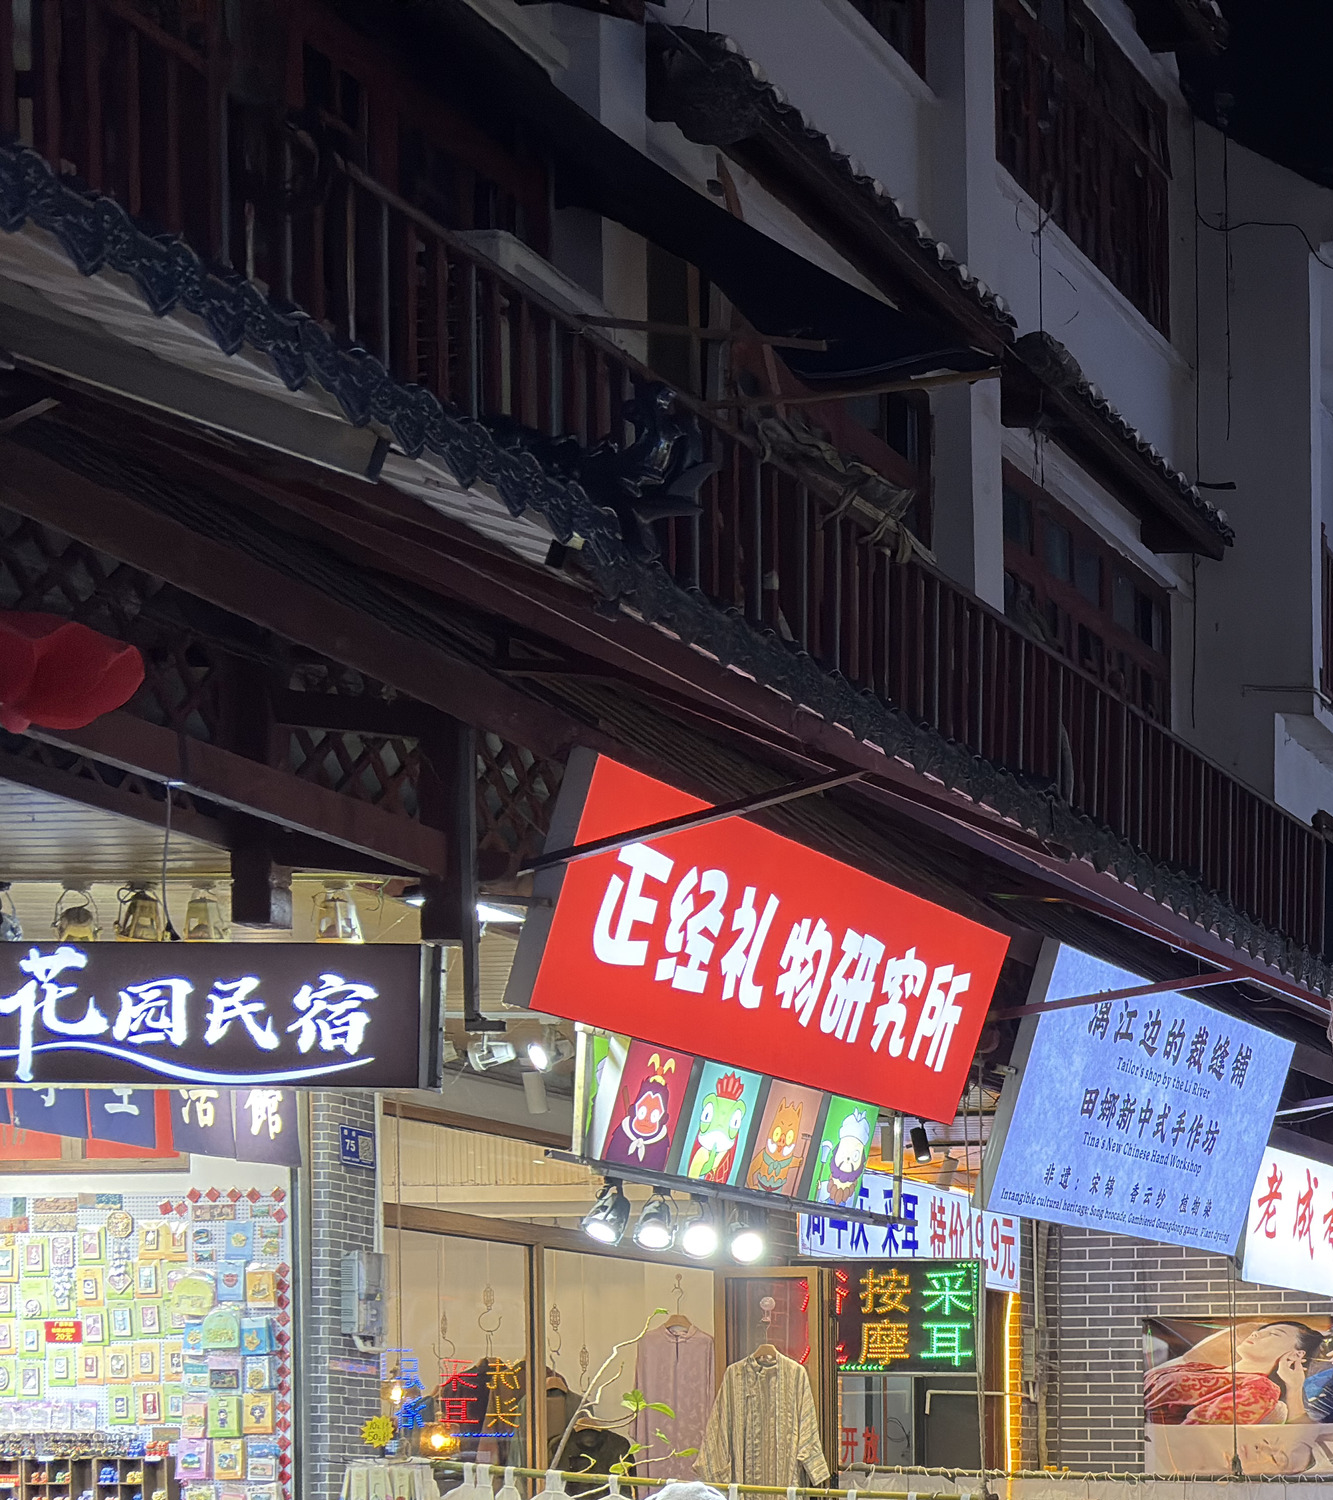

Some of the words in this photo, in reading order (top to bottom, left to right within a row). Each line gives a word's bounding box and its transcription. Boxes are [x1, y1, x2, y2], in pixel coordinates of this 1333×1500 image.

[593, 842, 971, 1072] 正经礼物研究所
[0, 945, 379, 1082] 花园民宿
[1087, 990, 1253, 1089] 漓江边的裁缝铺
[1116, 1056, 1145, 1078] Tailor's
[1145, 1066, 1162, 1087] shop
[1163, 1072, 1172, 1088] by
[1172, 1077, 1184, 1092] the
[1184, 1079, 1192, 1093] Li
[1192, 1082, 1211, 1100] River
[345, 1139, 356, 1151] 75
[1080, 1087, 1220, 1155] 田娜新中式手作坊
[1084, 1131, 1106, 1150] Tina's
[1107, 1136, 1122, 1154] New
[1123, 1142, 1150, 1162] Chinese
[1150, 1149, 1169, 1166] Hand
[1169, 1154, 1202, 1177] Workshop
[1001, 1186, 1036, 1206] Intangible
[1037, 1195, 1062, 1210] cultural
[1062, 1199, 1090, 1216] heritage:
[1089, 1204, 1104, 1220] Song
[1104, 1207, 1127, 1224] brocade,
[1127, 1213, 1155, 1228] Gambiered
[1155, 1218, 1183, 1235] Guangdong
[55, 1333, 73, 1341] 20元
[859, 1267, 912, 1365] 按摩
[920, 1270, 973, 1367] 采耳
